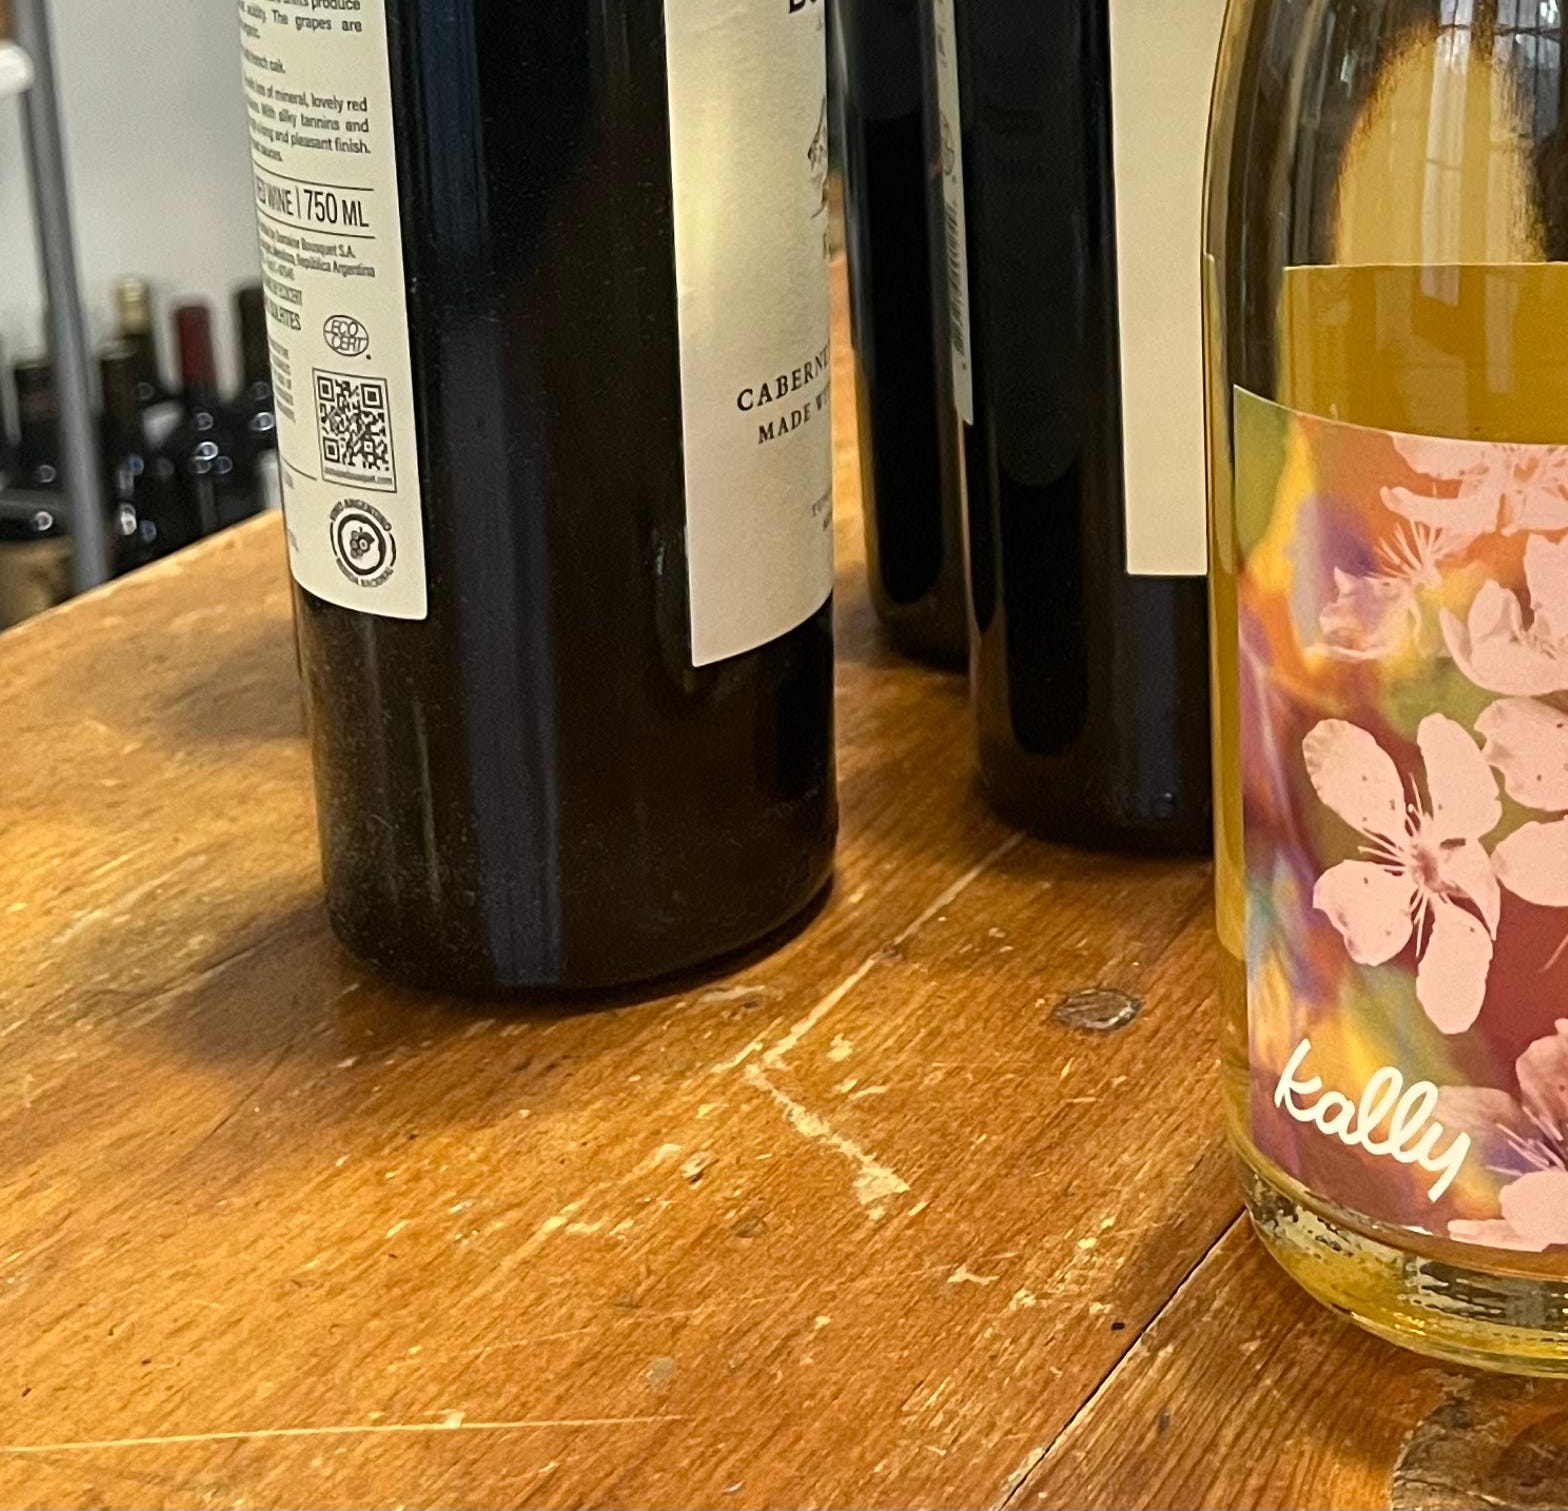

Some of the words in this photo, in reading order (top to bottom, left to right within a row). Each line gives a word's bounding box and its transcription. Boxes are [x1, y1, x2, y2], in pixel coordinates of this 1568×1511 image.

[295, 15, 332, 32] grapes
[341, 19, 363, 33] are
[311, 91, 344, 114] lovely
[347, 96, 368, 113] red
[300, 114, 340, 131] tannins
[345, 117, 370, 133] and
[291, 132, 334, 152] pleasant
[335, 137, 372, 154] finish.
[266, 183, 294, 216] WINE
[303, 188, 338, 224] 750
[341, 198, 370, 228] ML
[331, 319, 358, 337] ECO
[757, 402, 811, 445] MADE
[1274, 1037, 1472, 1203] kally
